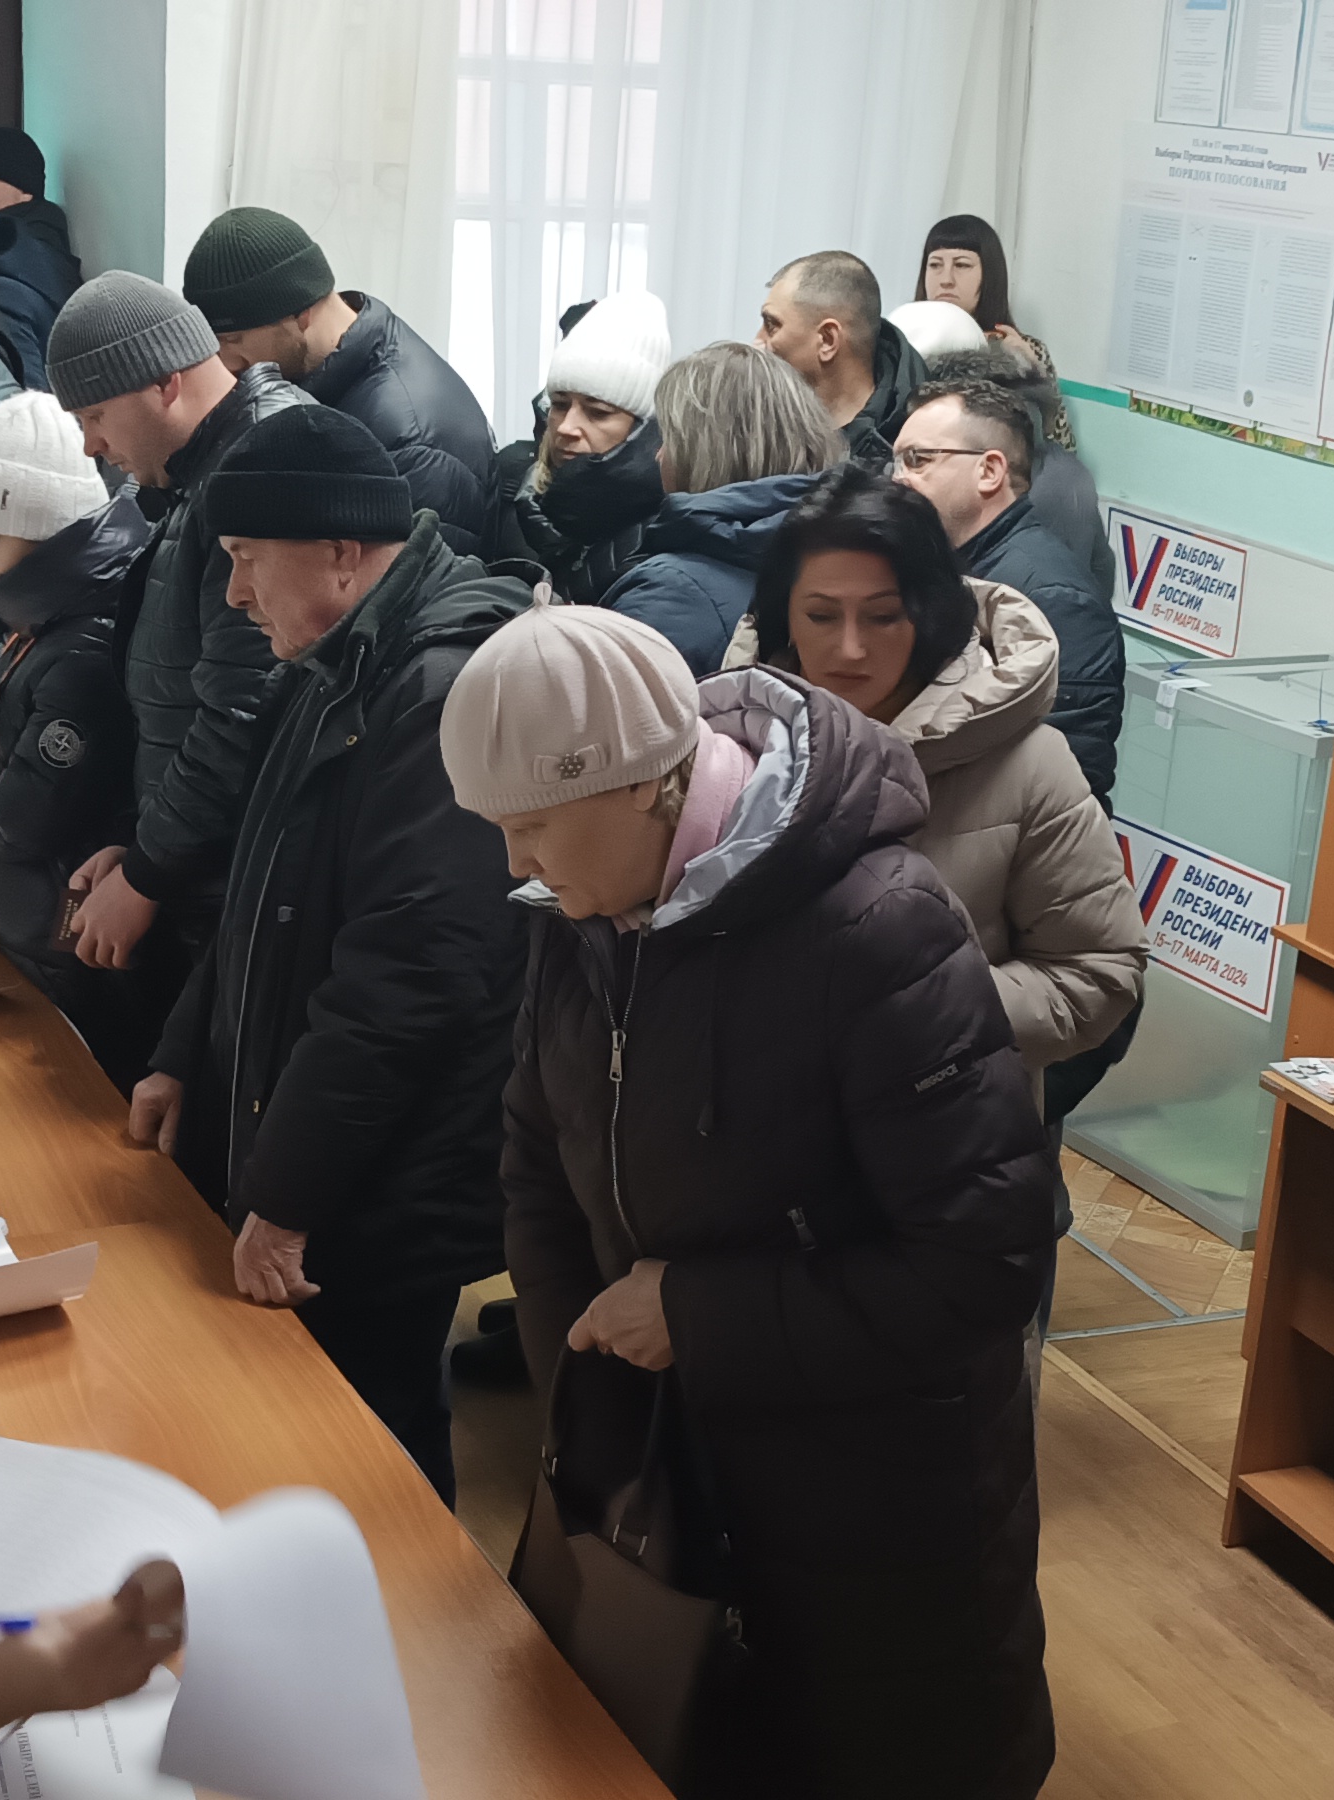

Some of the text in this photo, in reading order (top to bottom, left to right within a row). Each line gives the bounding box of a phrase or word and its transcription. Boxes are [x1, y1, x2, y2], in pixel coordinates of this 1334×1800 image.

[1169, 166, 1288, 191] ПОРЯДОК ГОЛОСОВАНИЯ
[1173, 542, 1225, 572] ВЫБОРЫ
[1157, 584, 1204, 612] РОССИИ
[1165, 563, 1238, 601] ПРЕЗИДЕНТА
[1173, 612, 1201, 632] МАРТА
[1200, 621, 1222, 640] 2024
[1182, 864, 1253, 908] ВЫБОРЫ
[1161, 910, 1224, 951] РОССИИ
[1172, 887, 1268, 945] ПРЕЗИДЕНТА
[1182, 945, 1221, 974] МАРТА
[1219, 963, 1250, 988] 2024
